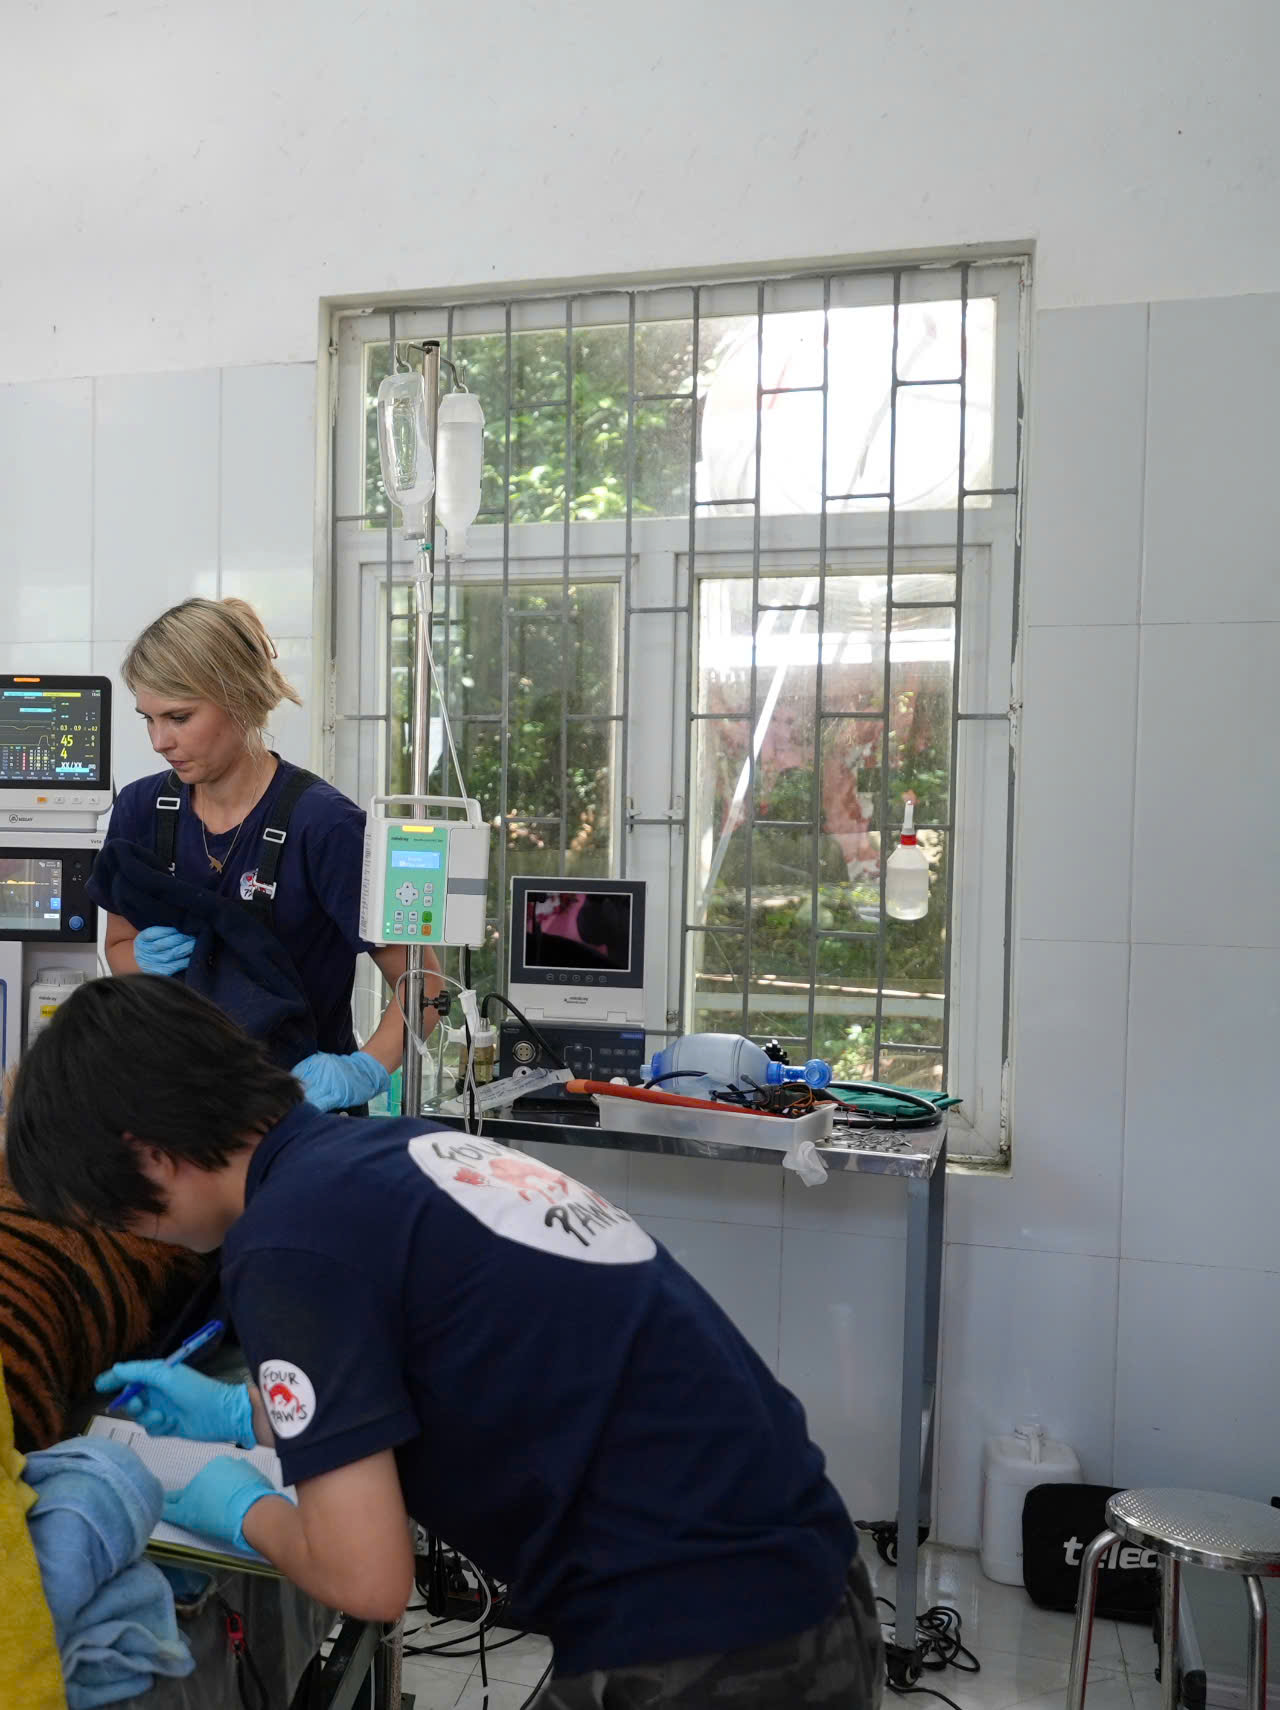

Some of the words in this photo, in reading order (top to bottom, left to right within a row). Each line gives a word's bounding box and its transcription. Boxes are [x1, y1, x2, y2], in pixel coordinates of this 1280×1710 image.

[60, 734, 74, 747] 45
[60, 747, 68, 759] 4
[262, 1366, 300, 1385] FOUR
[270, 1403, 308, 1424] PAWS
